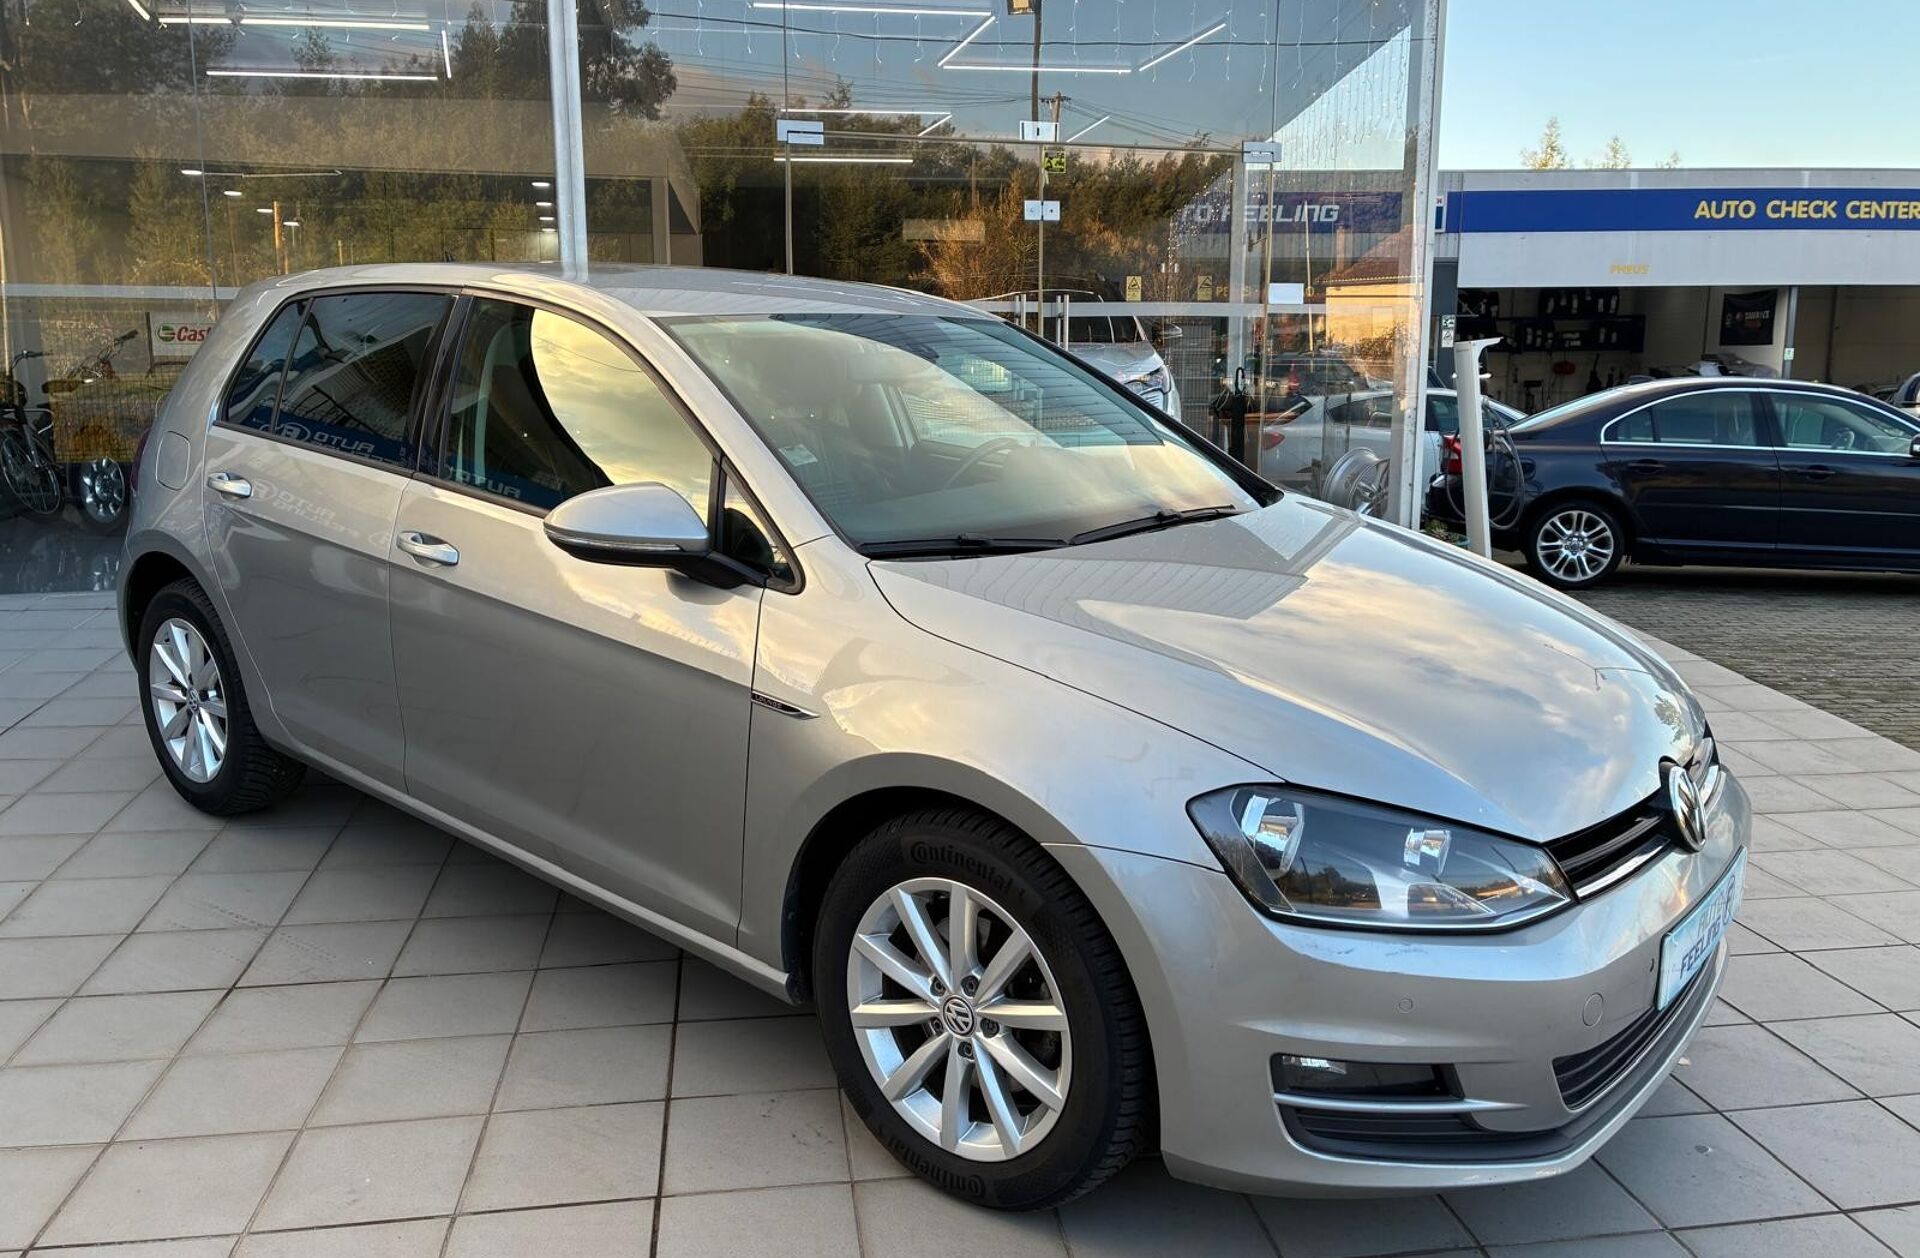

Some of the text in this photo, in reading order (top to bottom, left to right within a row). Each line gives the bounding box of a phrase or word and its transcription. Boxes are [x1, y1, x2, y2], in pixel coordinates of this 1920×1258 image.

[1694, 200, 1920, 220] AUTO CHECK CENTER
[910, 841, 1013, 893] Continental
[1680, 915, 1722, 980] FEELING
